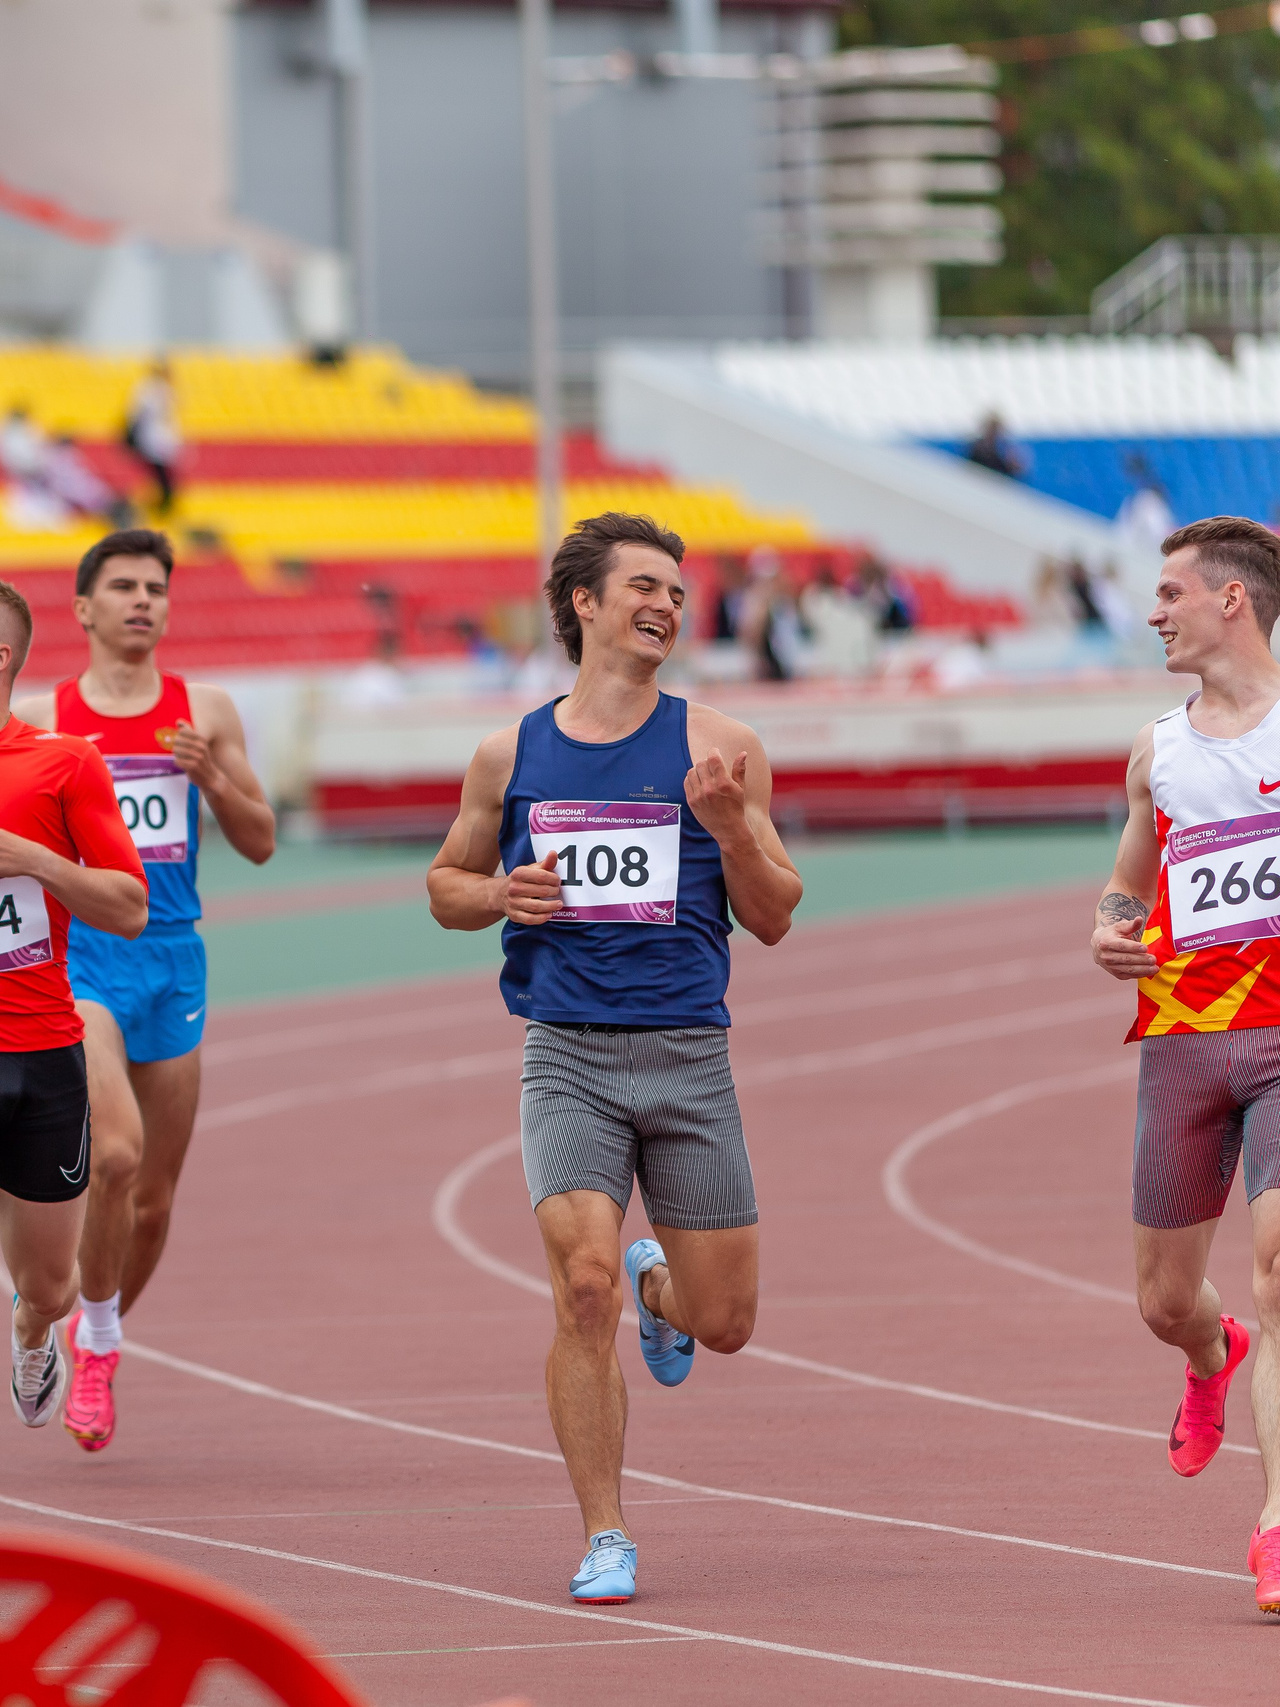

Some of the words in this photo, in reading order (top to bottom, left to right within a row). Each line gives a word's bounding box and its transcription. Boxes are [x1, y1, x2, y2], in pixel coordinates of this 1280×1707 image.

[119, 794, 168, 830] 00
[539, 808, 587, 816] ЧЕМПИОНАТ
[587, 816, 635, 824] ФЕДЕРАЛЬНОГО
[1174, 829, 1217, 846] ПЕРВЕНСТВО
[1174, 837, 1214, 852] ПРИВОЛЖСКОГО
[1214, 829, 1261, 842] ФЕДЕРАЛЬНОГО
[1261, 827, 1280, 835] ОКРУГ
[557, 844, 650, 888] 108
[1190, 856, 1280, 913] 266
[552, 910, 578, 918] БОКСАРЫ
[1181, 934, 1216, 948] ЧЕБОКСАРЫ
